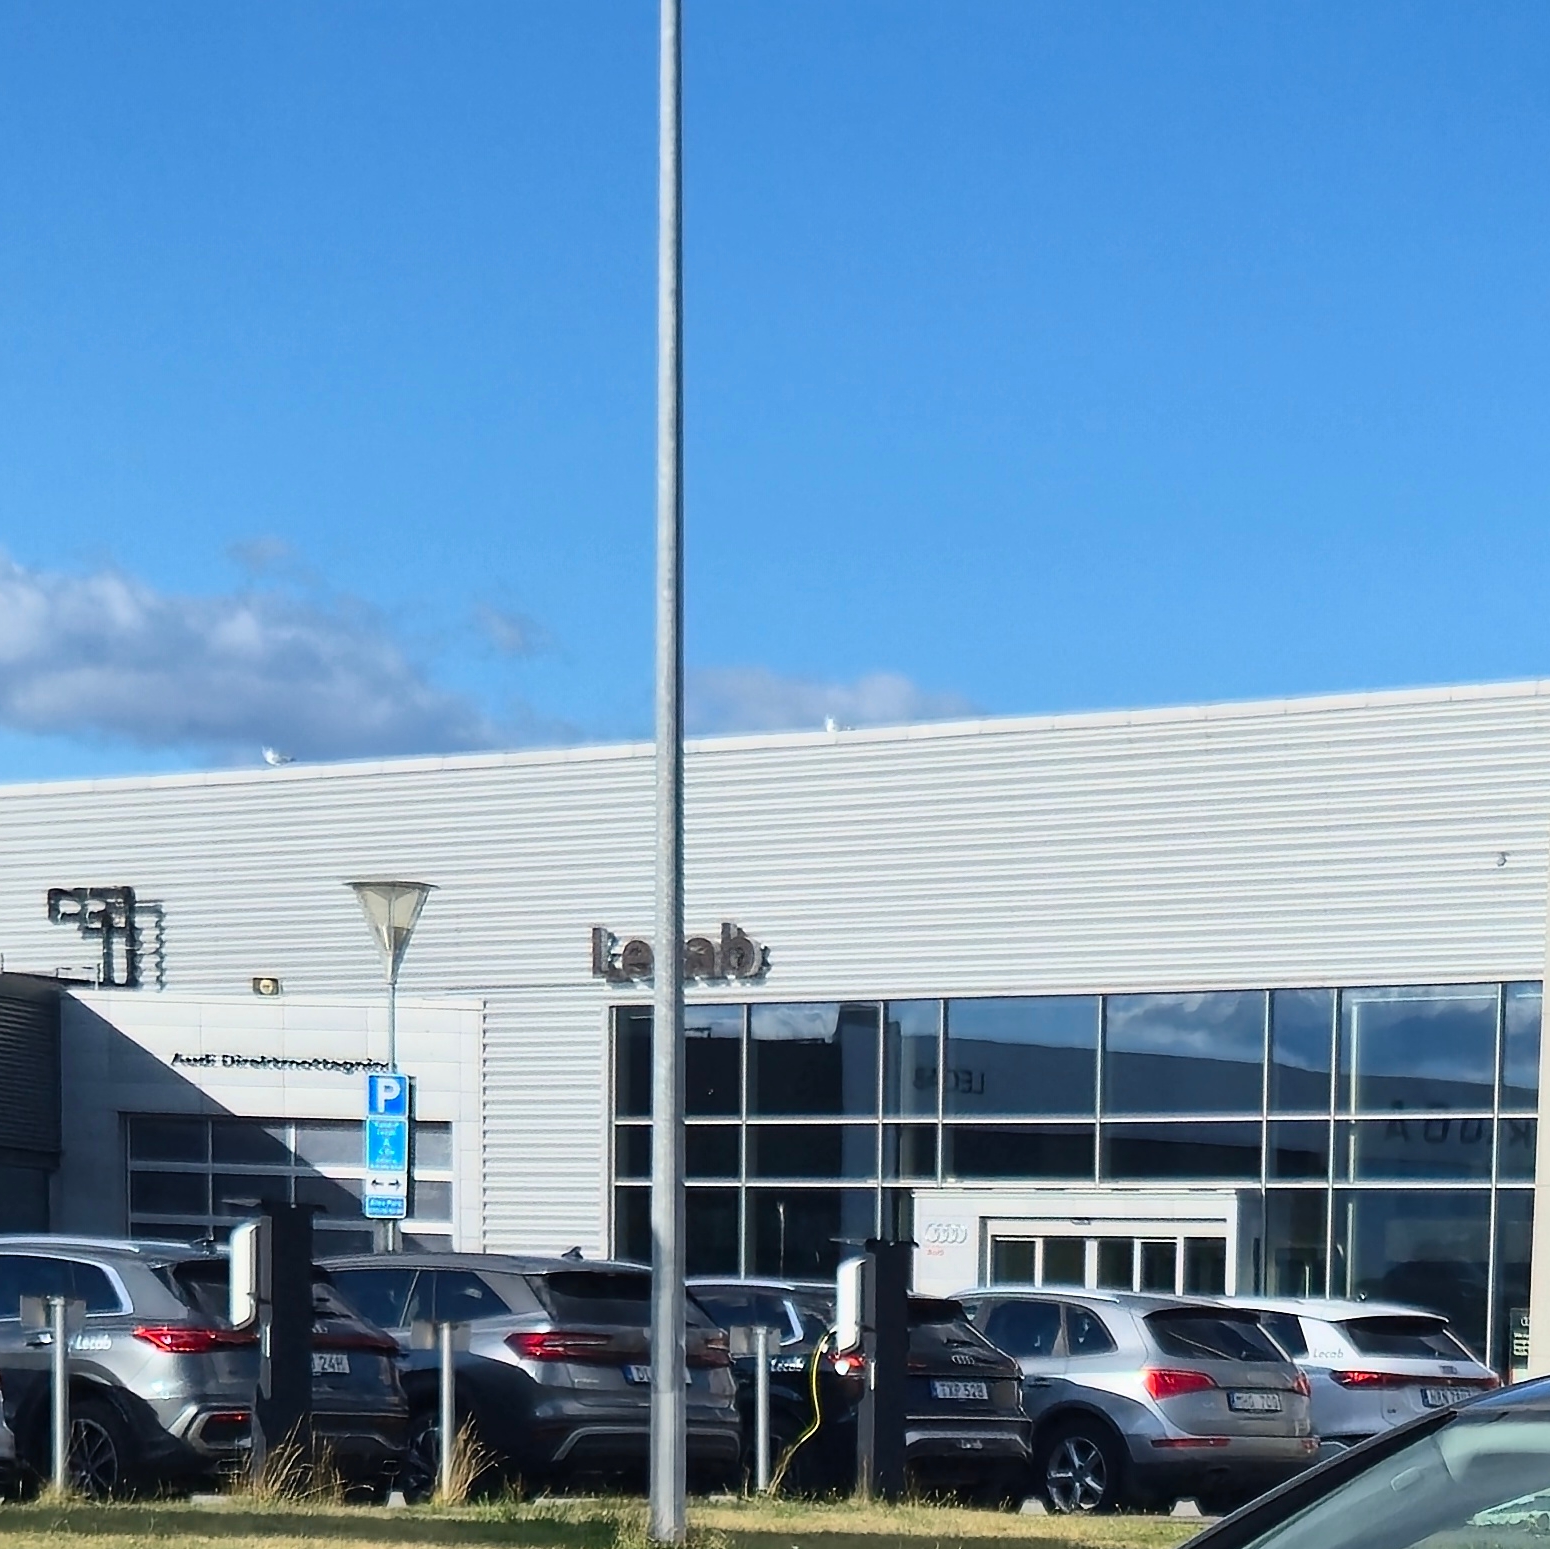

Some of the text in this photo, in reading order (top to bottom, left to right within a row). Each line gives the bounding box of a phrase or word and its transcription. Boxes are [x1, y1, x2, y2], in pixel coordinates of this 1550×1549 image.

[592, 922, 762, 979] Leab
[376, 1077, 401, 1113] P
[1313, 1347, 1344, 1359] Lecab
